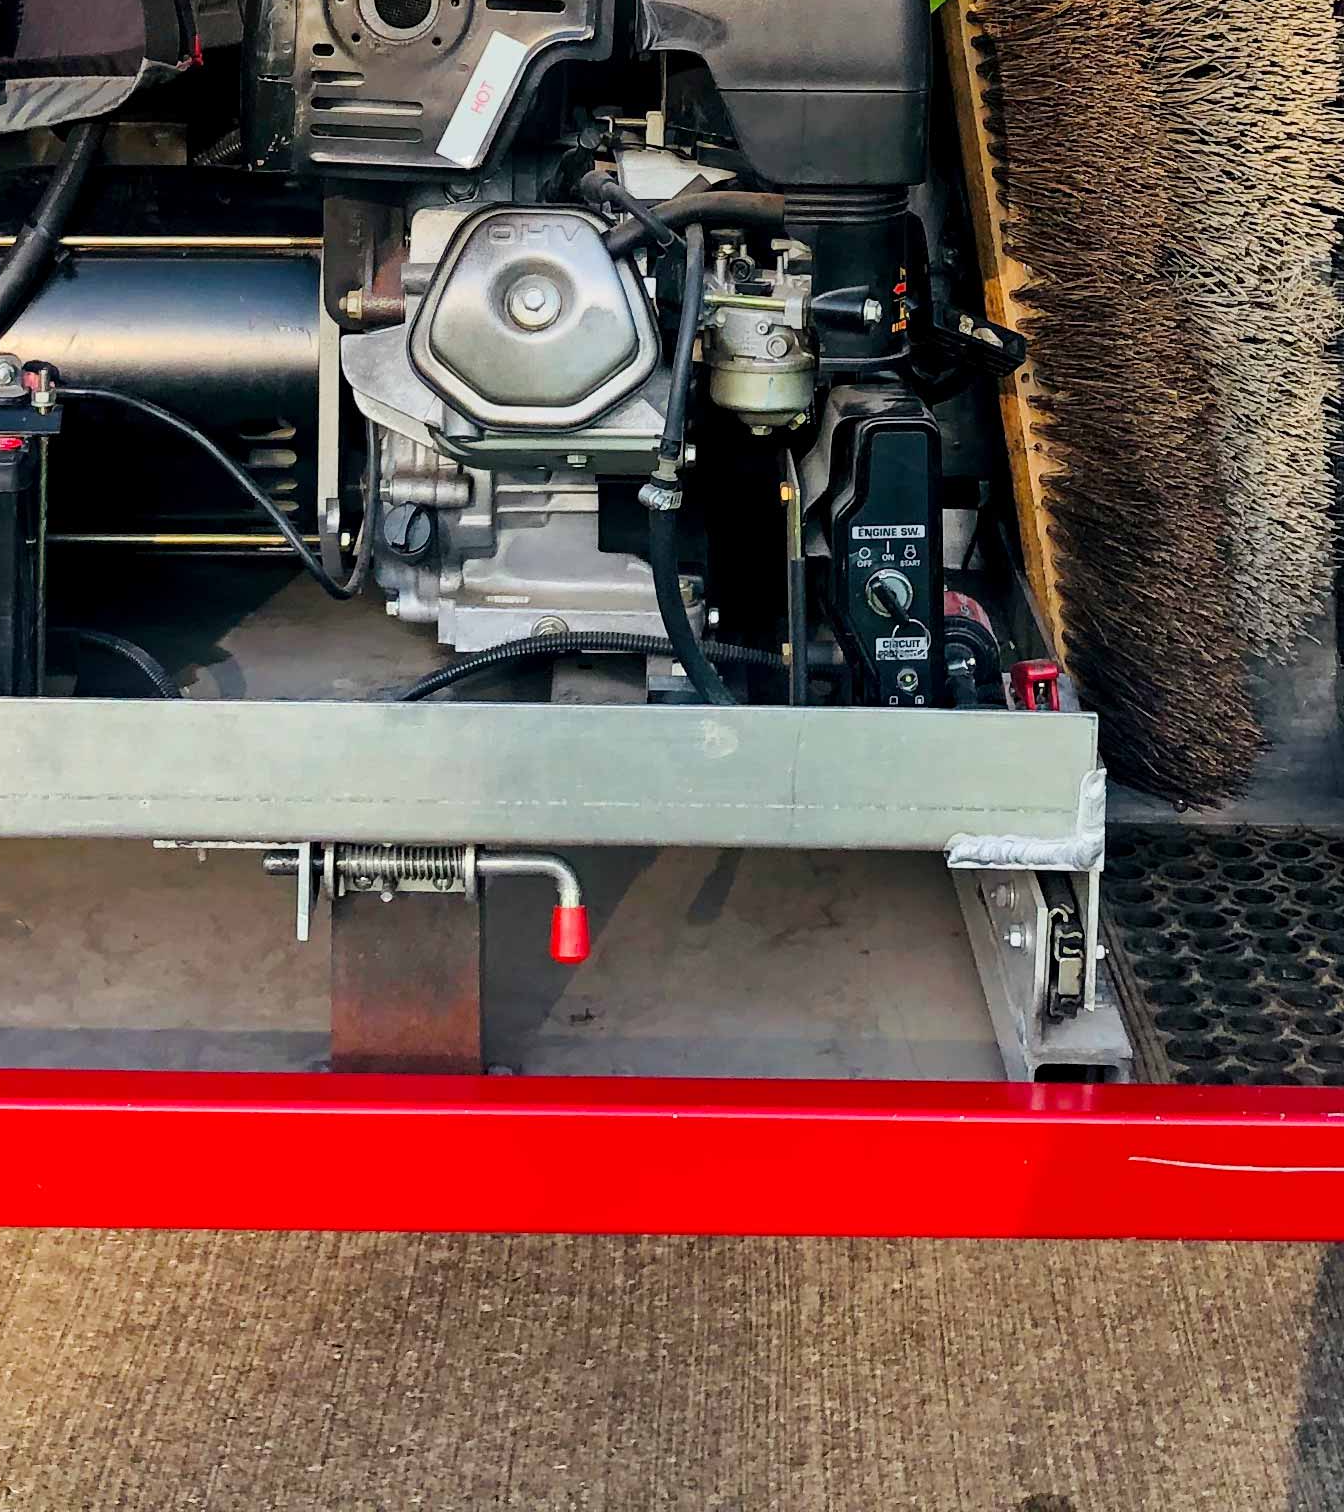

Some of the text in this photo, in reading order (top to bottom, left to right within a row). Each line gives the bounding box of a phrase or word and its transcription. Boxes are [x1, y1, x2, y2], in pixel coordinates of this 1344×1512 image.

[470, 79, 494, 115] HOT
[488, 223, 582, 245] OHV
[858, 527, 897, 538] ENGINE
[881, 553, 895, 562] ON
[856, 559, 873, 568] OFF
[899, 559, 921, 567] START
